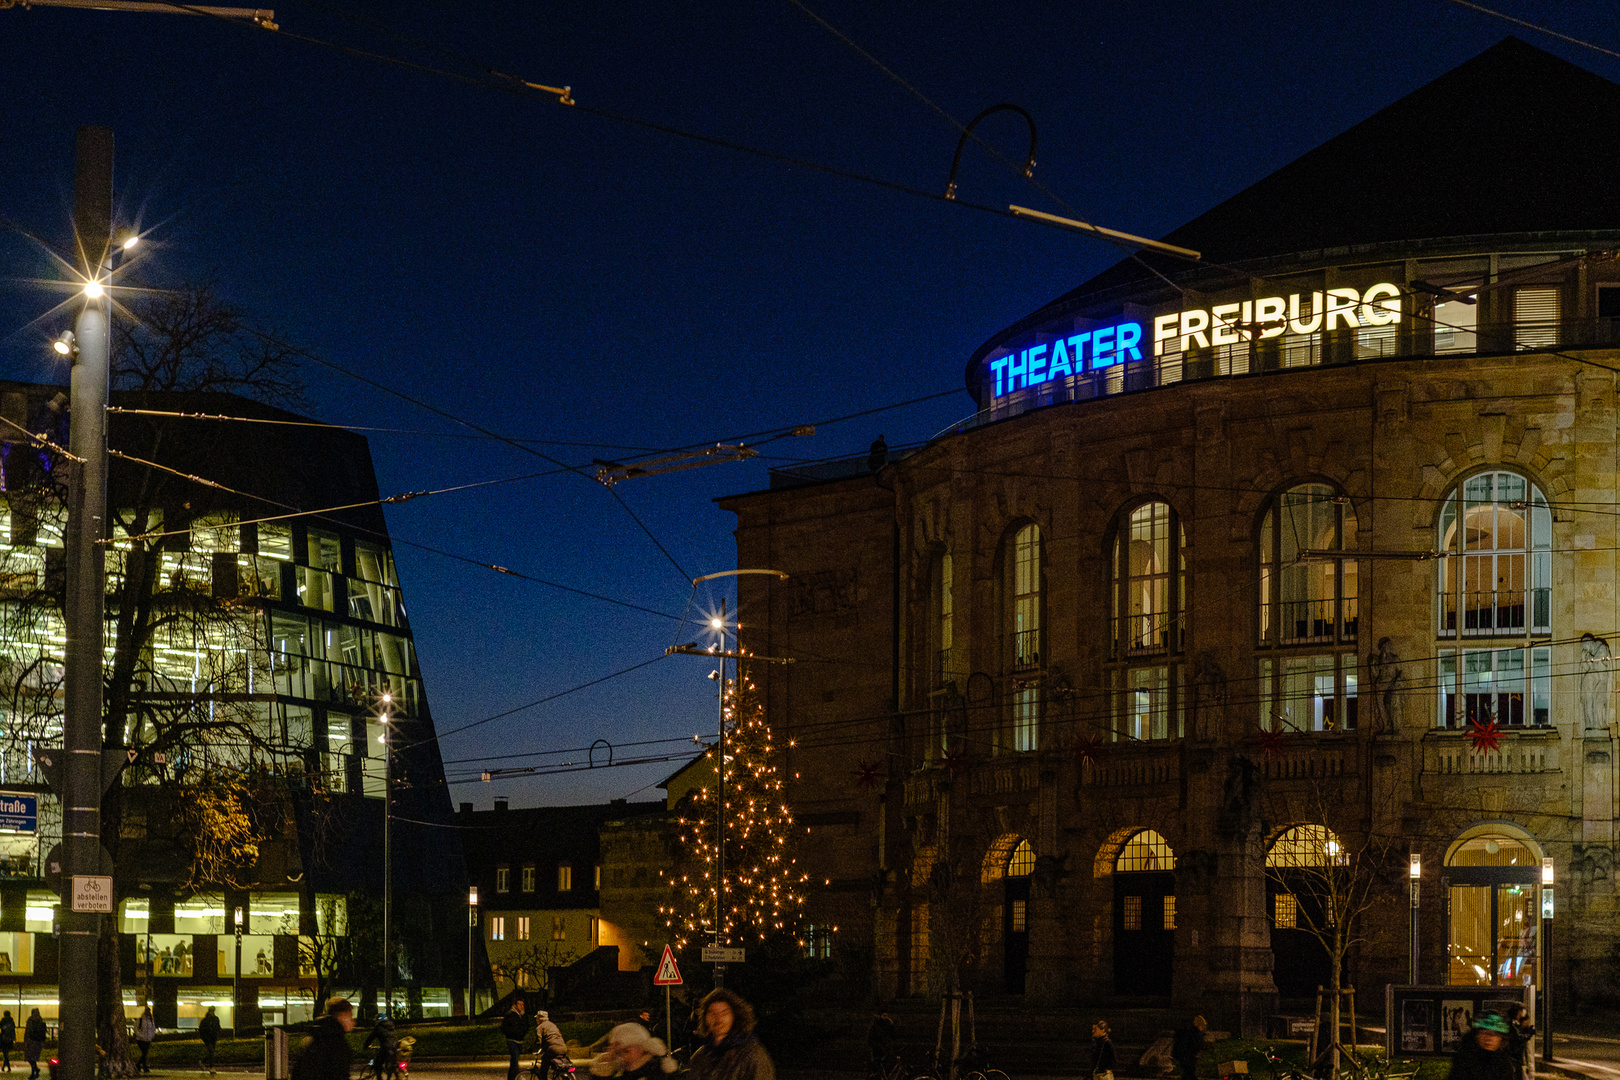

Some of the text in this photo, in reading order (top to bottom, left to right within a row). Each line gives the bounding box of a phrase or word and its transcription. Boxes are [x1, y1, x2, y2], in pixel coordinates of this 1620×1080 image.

[990, 282, 1401, 397] THEATER FREIBURG
[77, 892, 108, 901] abstellen
[77, 901, 108, 909] verboten
